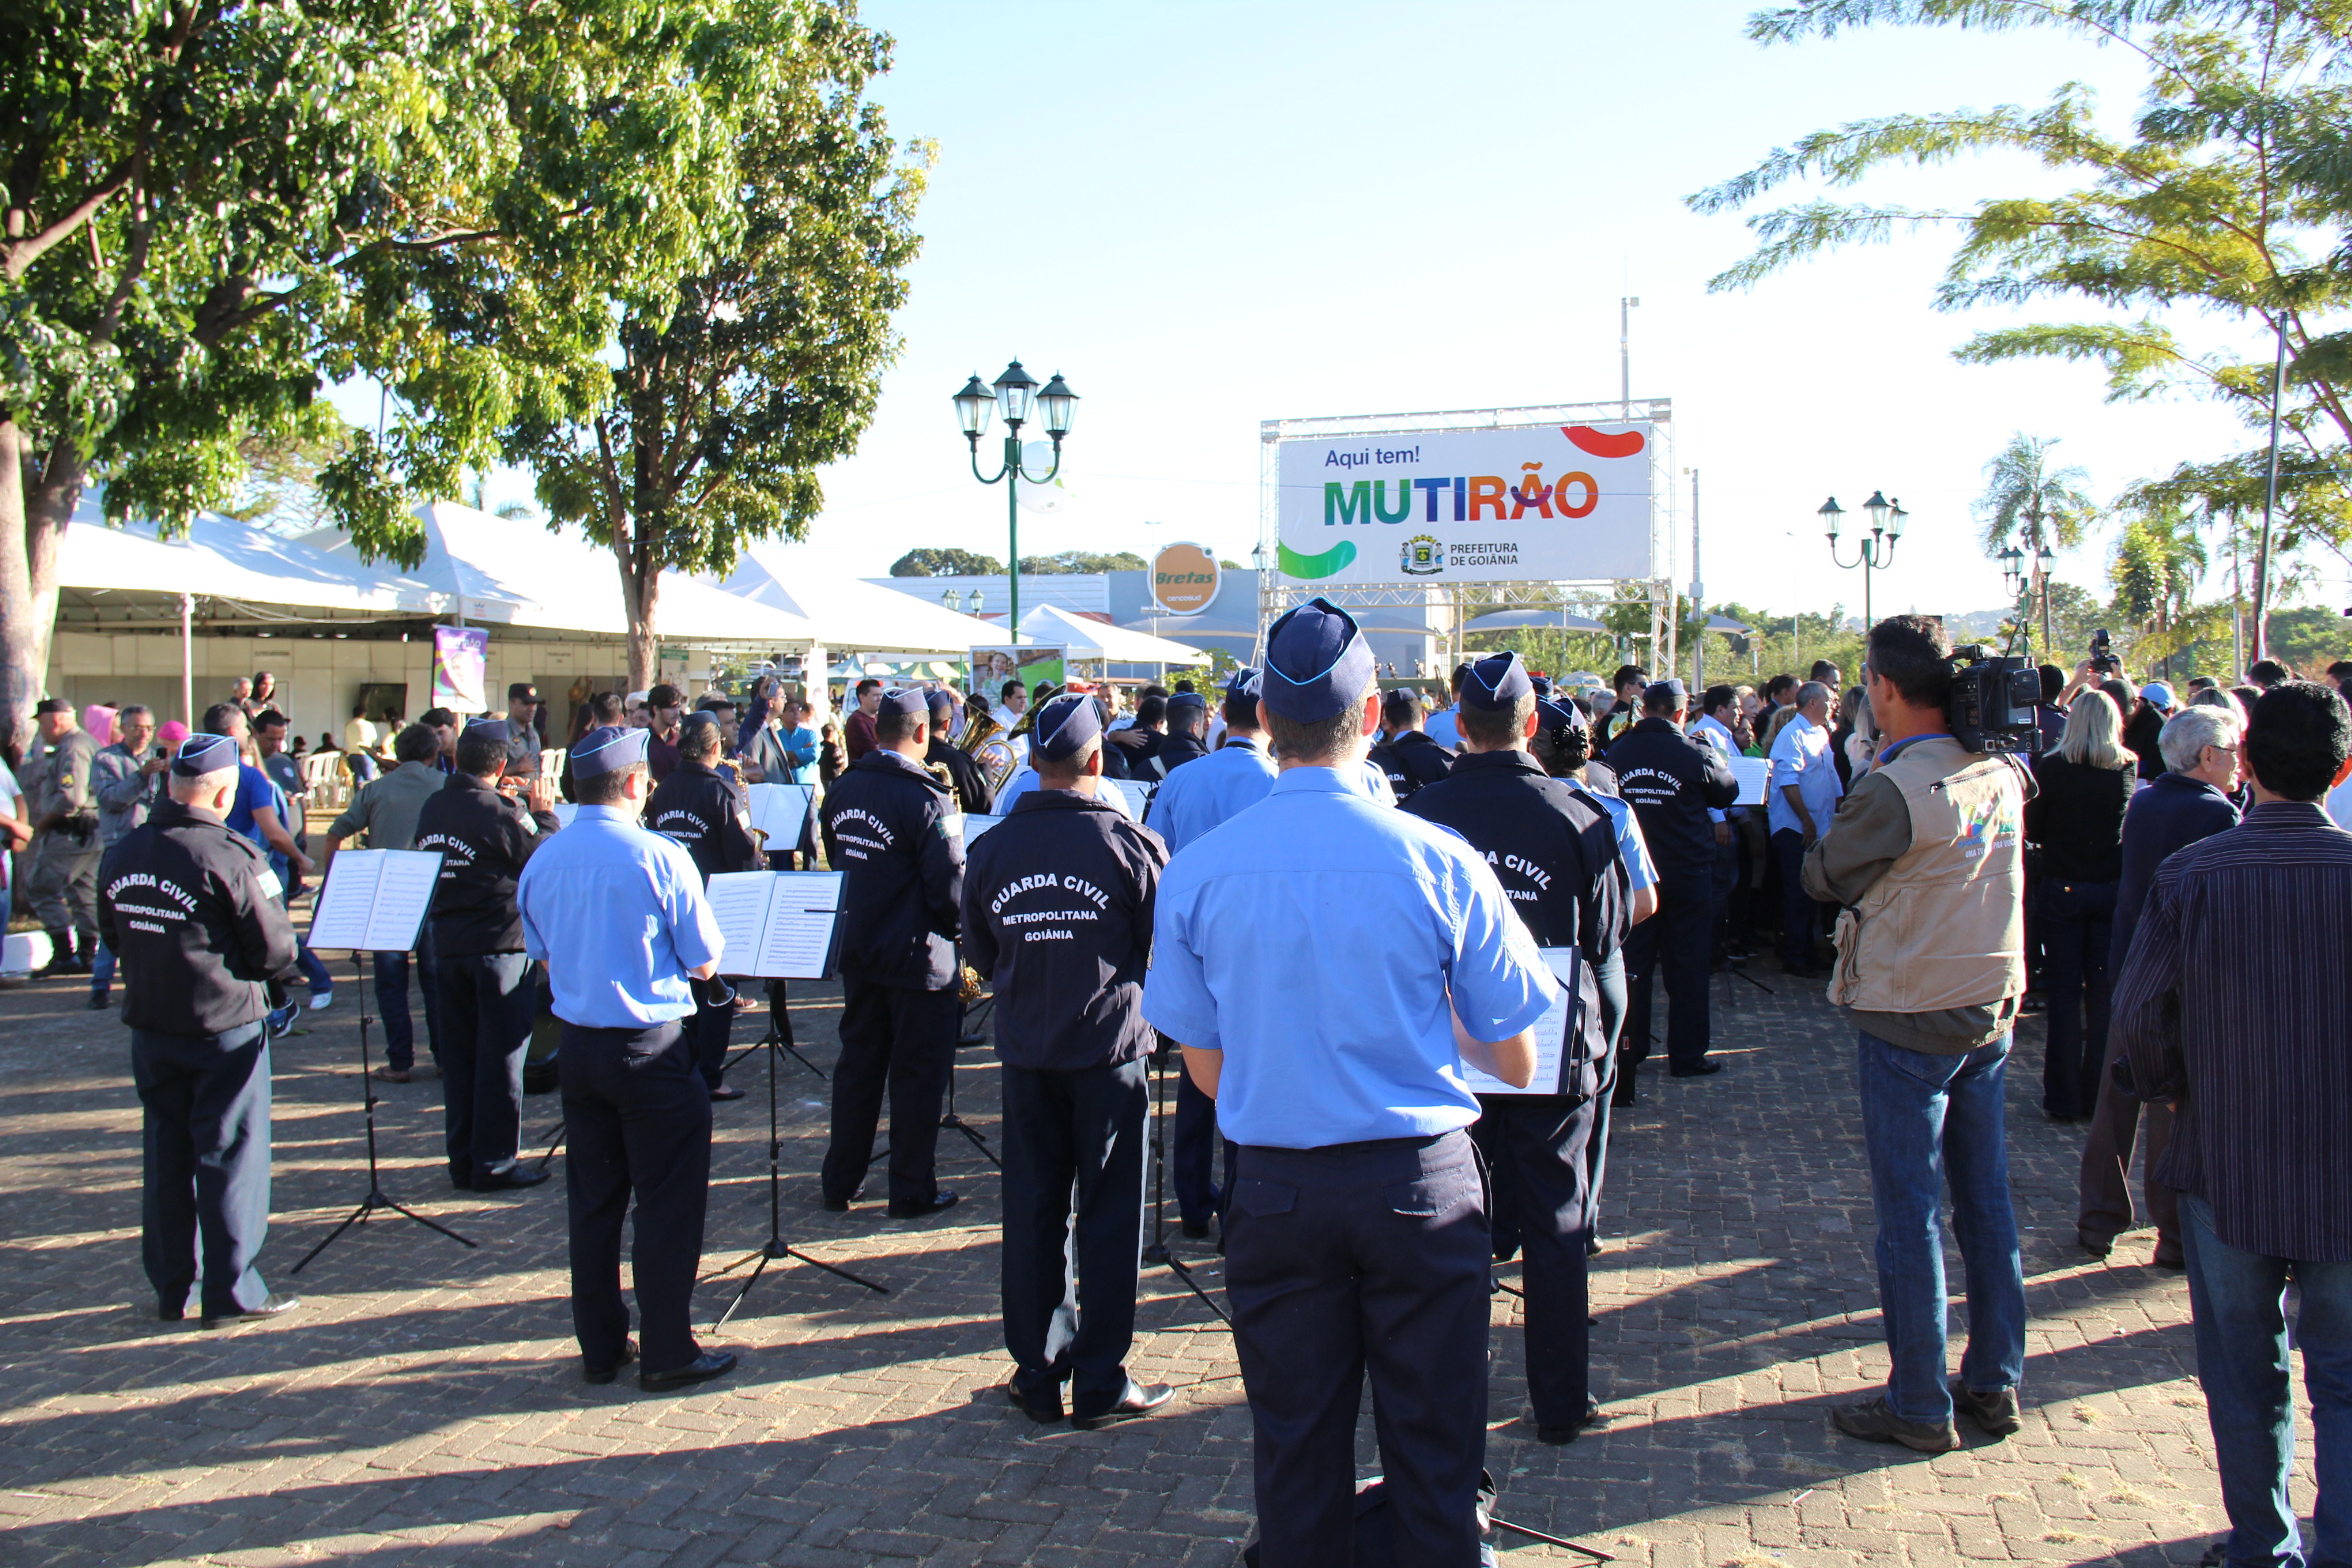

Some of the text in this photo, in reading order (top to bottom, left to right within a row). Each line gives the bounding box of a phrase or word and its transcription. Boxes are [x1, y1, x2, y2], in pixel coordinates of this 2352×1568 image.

[1324, 446, 1420, 470] Aqui tem!
[1324, 461, 1599, 525] MUTIRÃO
[1450, 542, 1518, 554] PREFEITURA
[1450, 553, 1518, 566] DE GOIÂNIA
[1155, 572, 1214, 584] Bretas
[1386, 773, 1406, 782] RDA
[1619, 768, 1682, 791] GUARDA CIVIL
[687, 813, 708, 834] CIVIL
[832, 808, 894, 845] GUARDA CIVIL
[418, 834, 476, 860] UARDA CIVIL
[836, 833, 885, 851] METROPOLITANA
[845, 848, 868, 860] GOIÂNIA
[1965, 849, 1977, 858] UMA
[1505, 854, 1552, 891] CIVIL
[106, 873, 199, 913] GUARDA CIVIL
[992, 873, 1109, 914] GUARDA CIVIL
[114, 903, 186, 921] METROPOLITANA
[1002, 911, 1098, 926] METROPOLITANA
[129, 920, 165, 934] GOIÂNIA
[1024, 929, 1073, 942] GOIÂNIA
